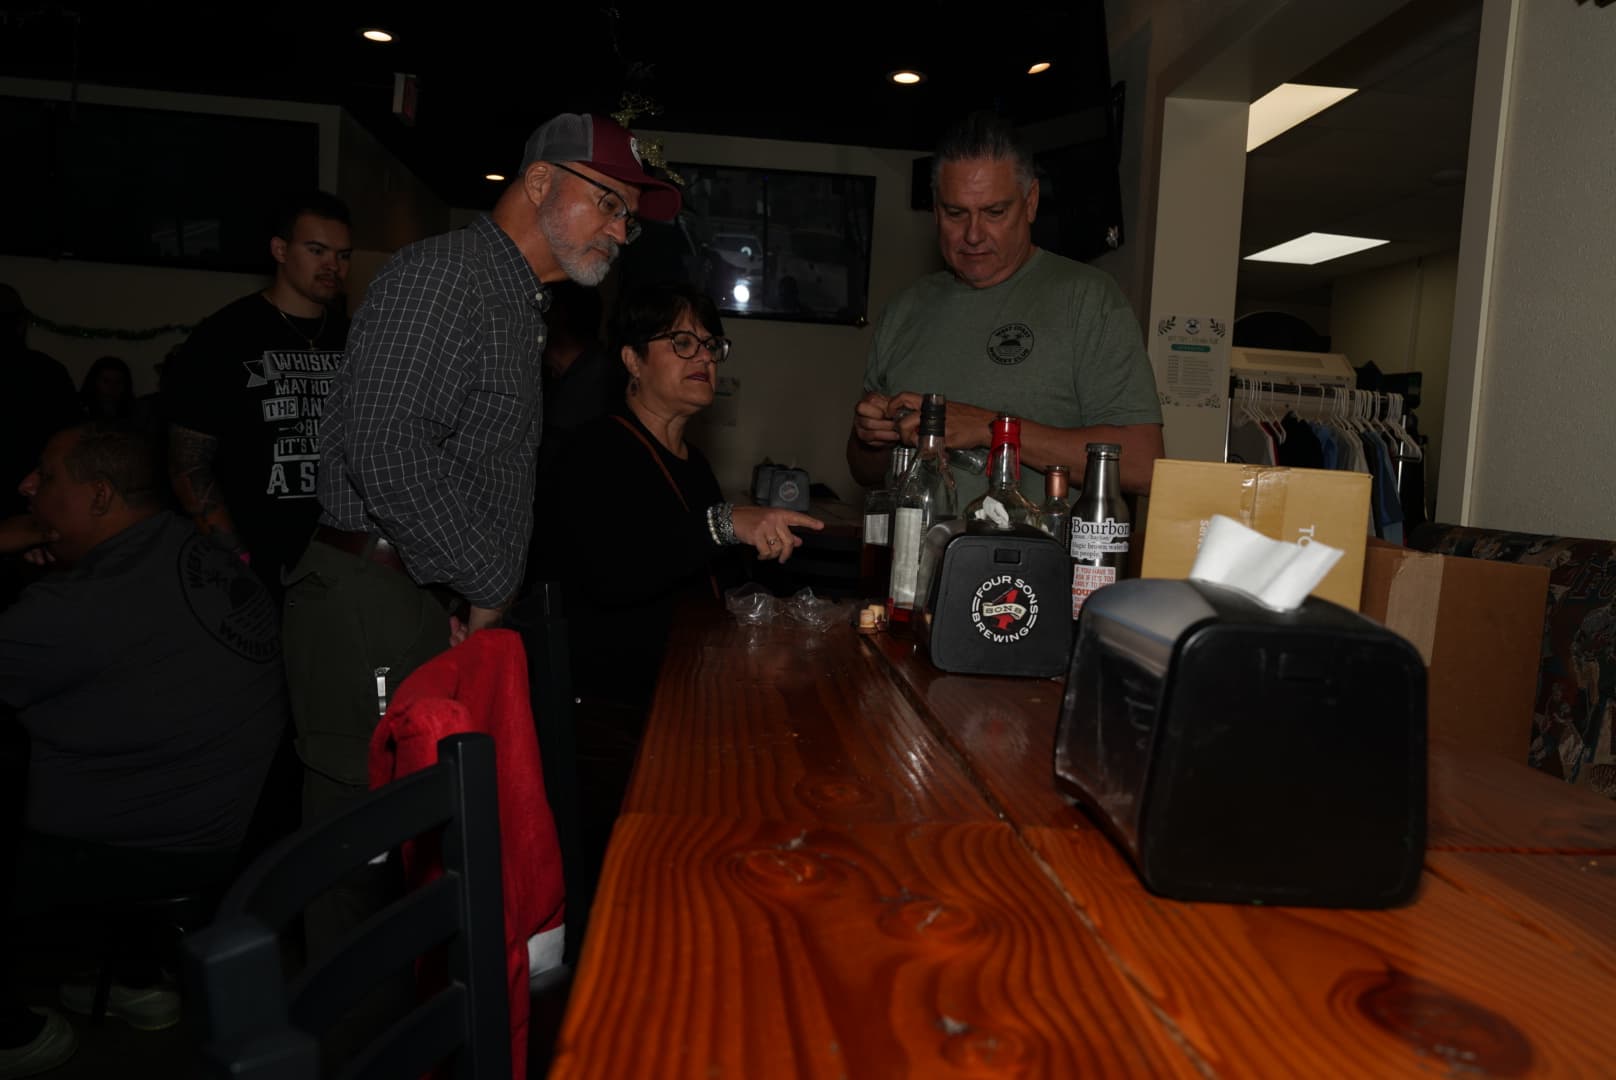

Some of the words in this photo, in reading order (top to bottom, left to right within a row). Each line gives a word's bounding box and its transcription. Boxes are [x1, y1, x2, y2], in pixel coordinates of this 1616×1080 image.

[274, 379, 307, 396] MAY
[265, 400, 296, 417] THE
[279, 438, 307, 456] IT'S
[266, 463, 290, 495] A
[976, 575, 1012, 598] FOUR
[1014, 578, 1039, 614] SONS
[971, 612, 1030, 643] BREWING
